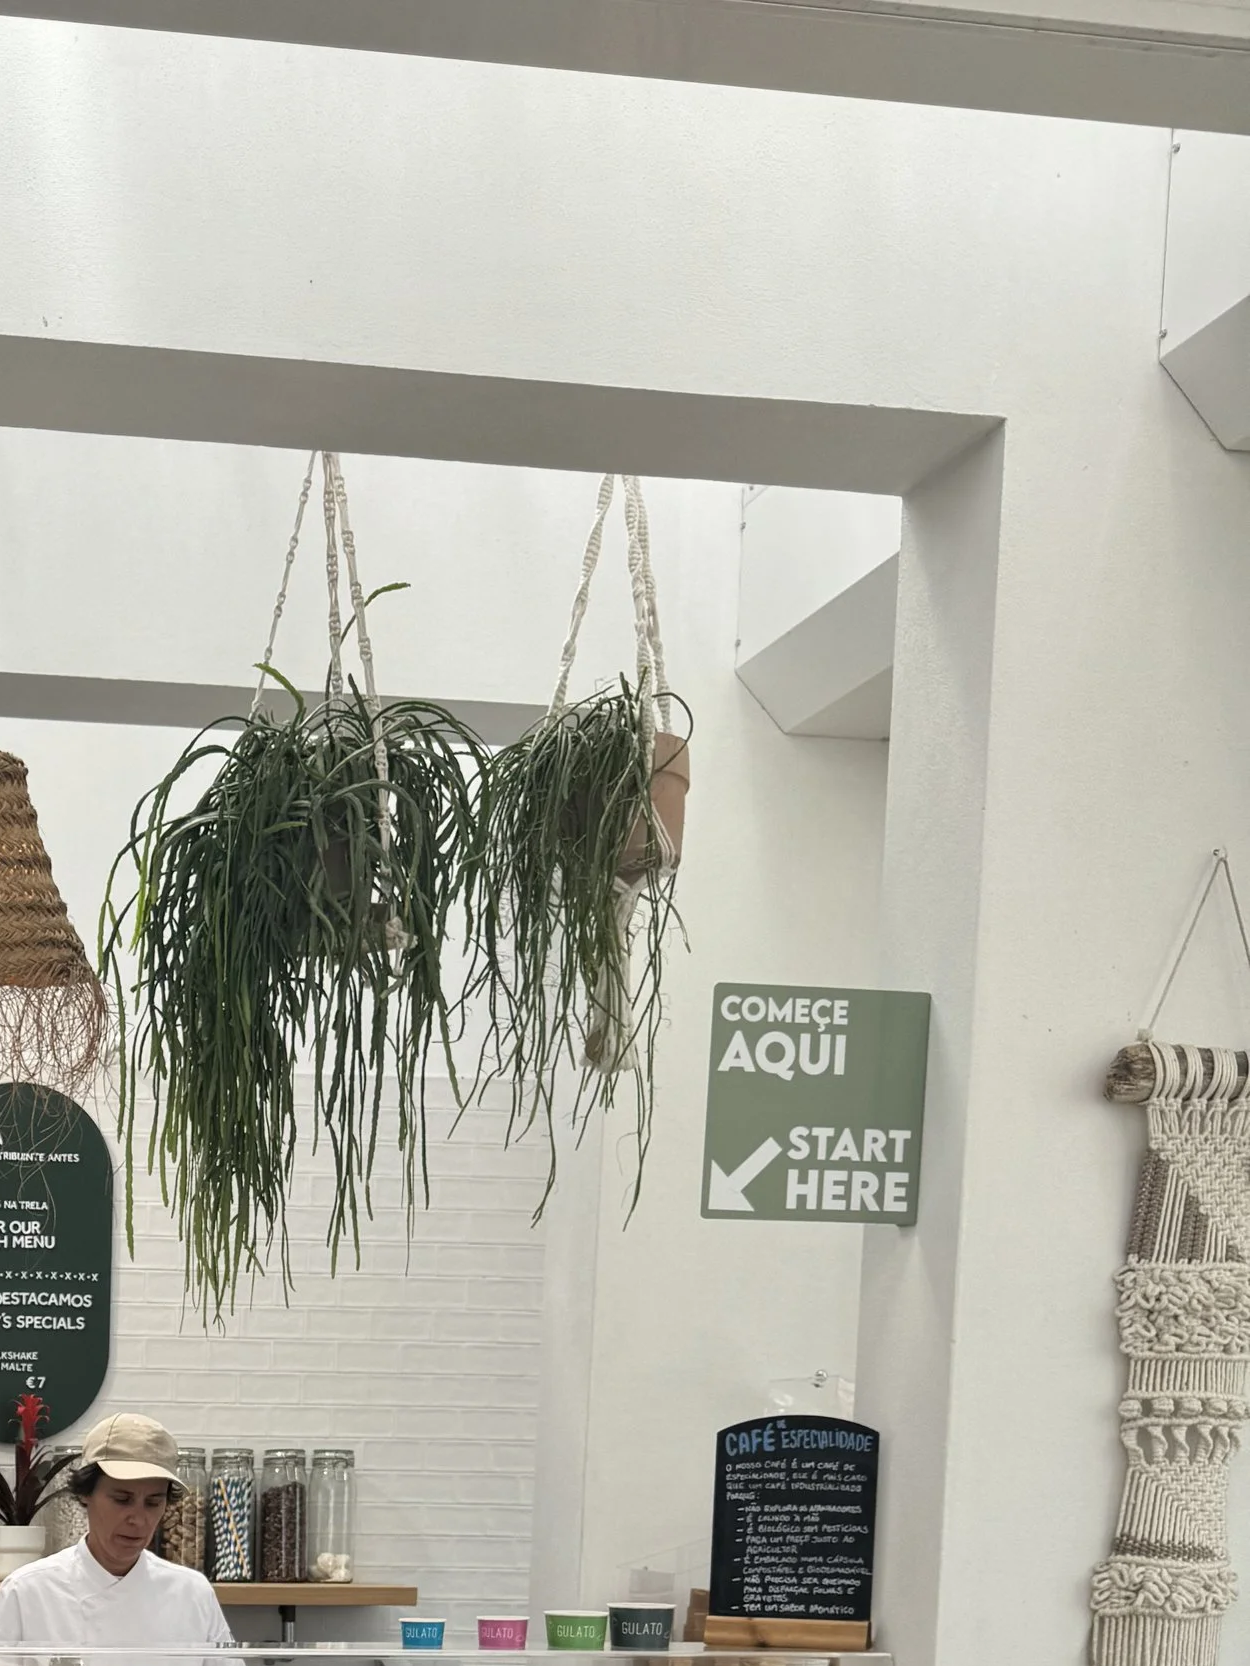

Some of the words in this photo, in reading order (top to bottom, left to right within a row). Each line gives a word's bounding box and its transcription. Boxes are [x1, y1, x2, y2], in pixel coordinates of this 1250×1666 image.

[721, 995, 849, 1032] COMEÇE
[717, 1030, 847, 1081] AQUI
[787, 1126, 911, 1163] START
[48, 1153, 79, 1162] ANTES
[786, 1169, 909, 1213] HERE
[4, 1201, 17, 1209] NA
[19, 1201, 48, 1210] TRELA
[9, 1221, 41, 1234] OUR
[12, 1235, 55, 1249] MENU
[16, 1316, 85, 1330] SPECIALS
[1, 1363, 33, 1372] MALTE
[725, 1423, 776, 1456] CAFÉ
[405, 1628, 437, 1638] GULATO
[481, 1628, 513, 1639] GULATO
[557, 1625, 595, 1639] GULATO
[622, 1622, 662, 1635] GULATO
